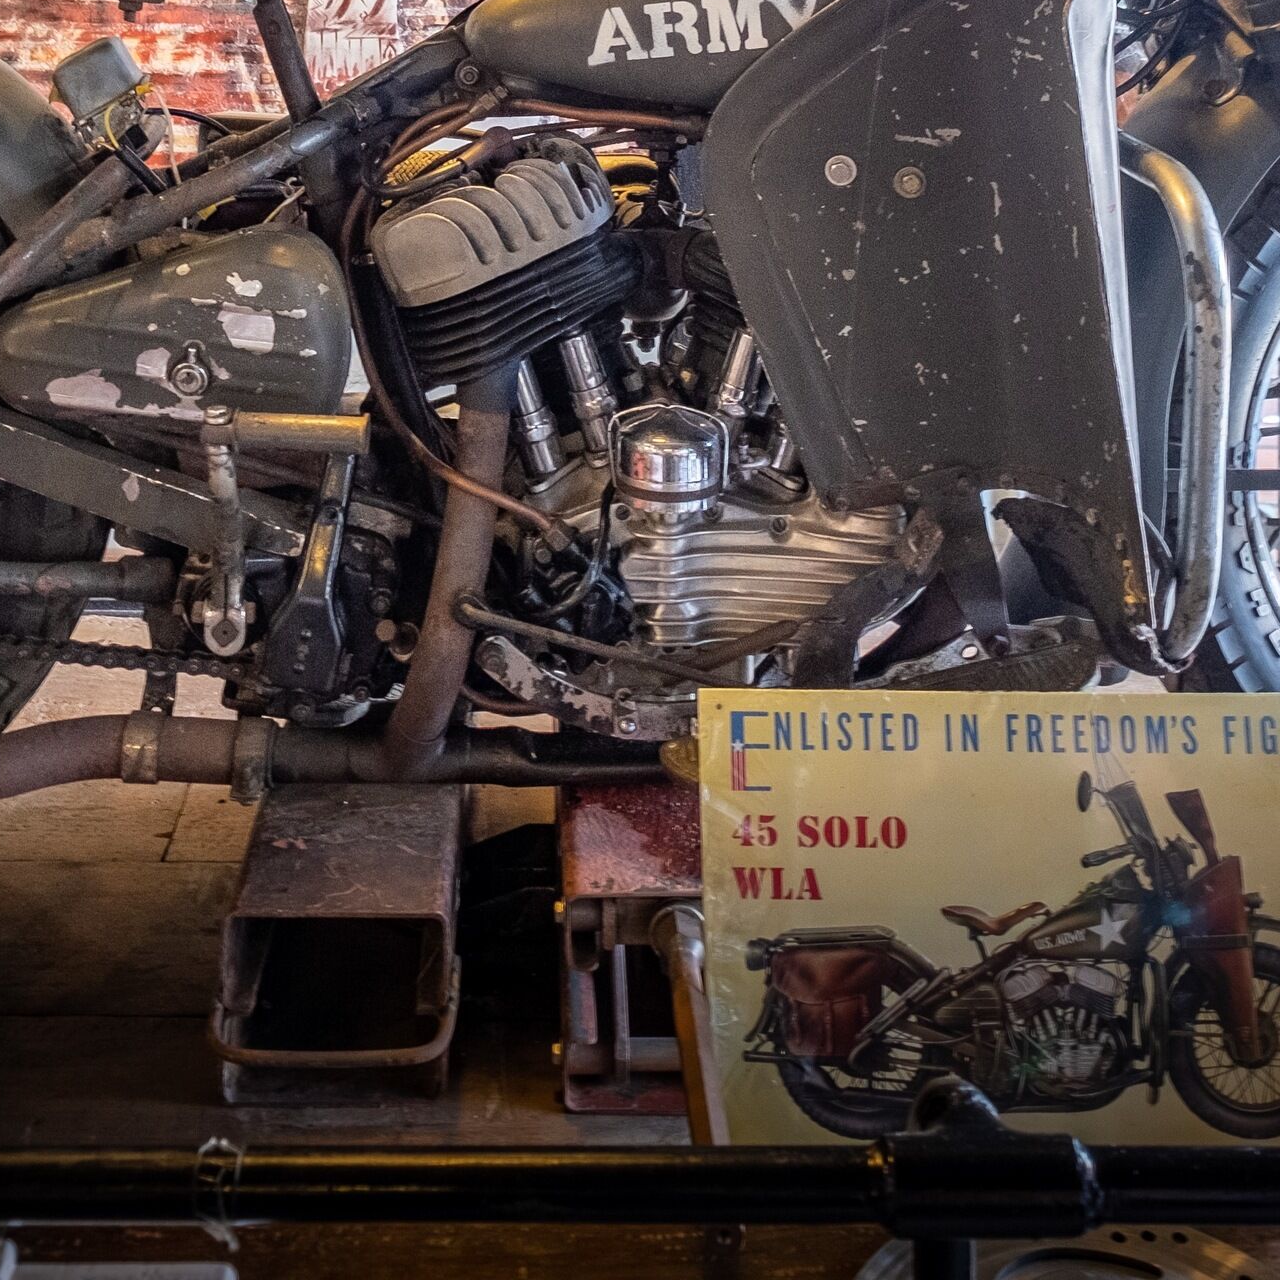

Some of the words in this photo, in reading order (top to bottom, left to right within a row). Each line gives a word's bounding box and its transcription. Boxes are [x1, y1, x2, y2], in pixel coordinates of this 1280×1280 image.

[729, 710, 920, 793] ENLISTED
[944, 713, 980, 753] IN
[1005, 712, 1198, 755] FREEDOM'S
[731, 813, 778, 849] 45
[796, 815, 908, 850] SOLO
[732, 866, 823, 901] WLA
